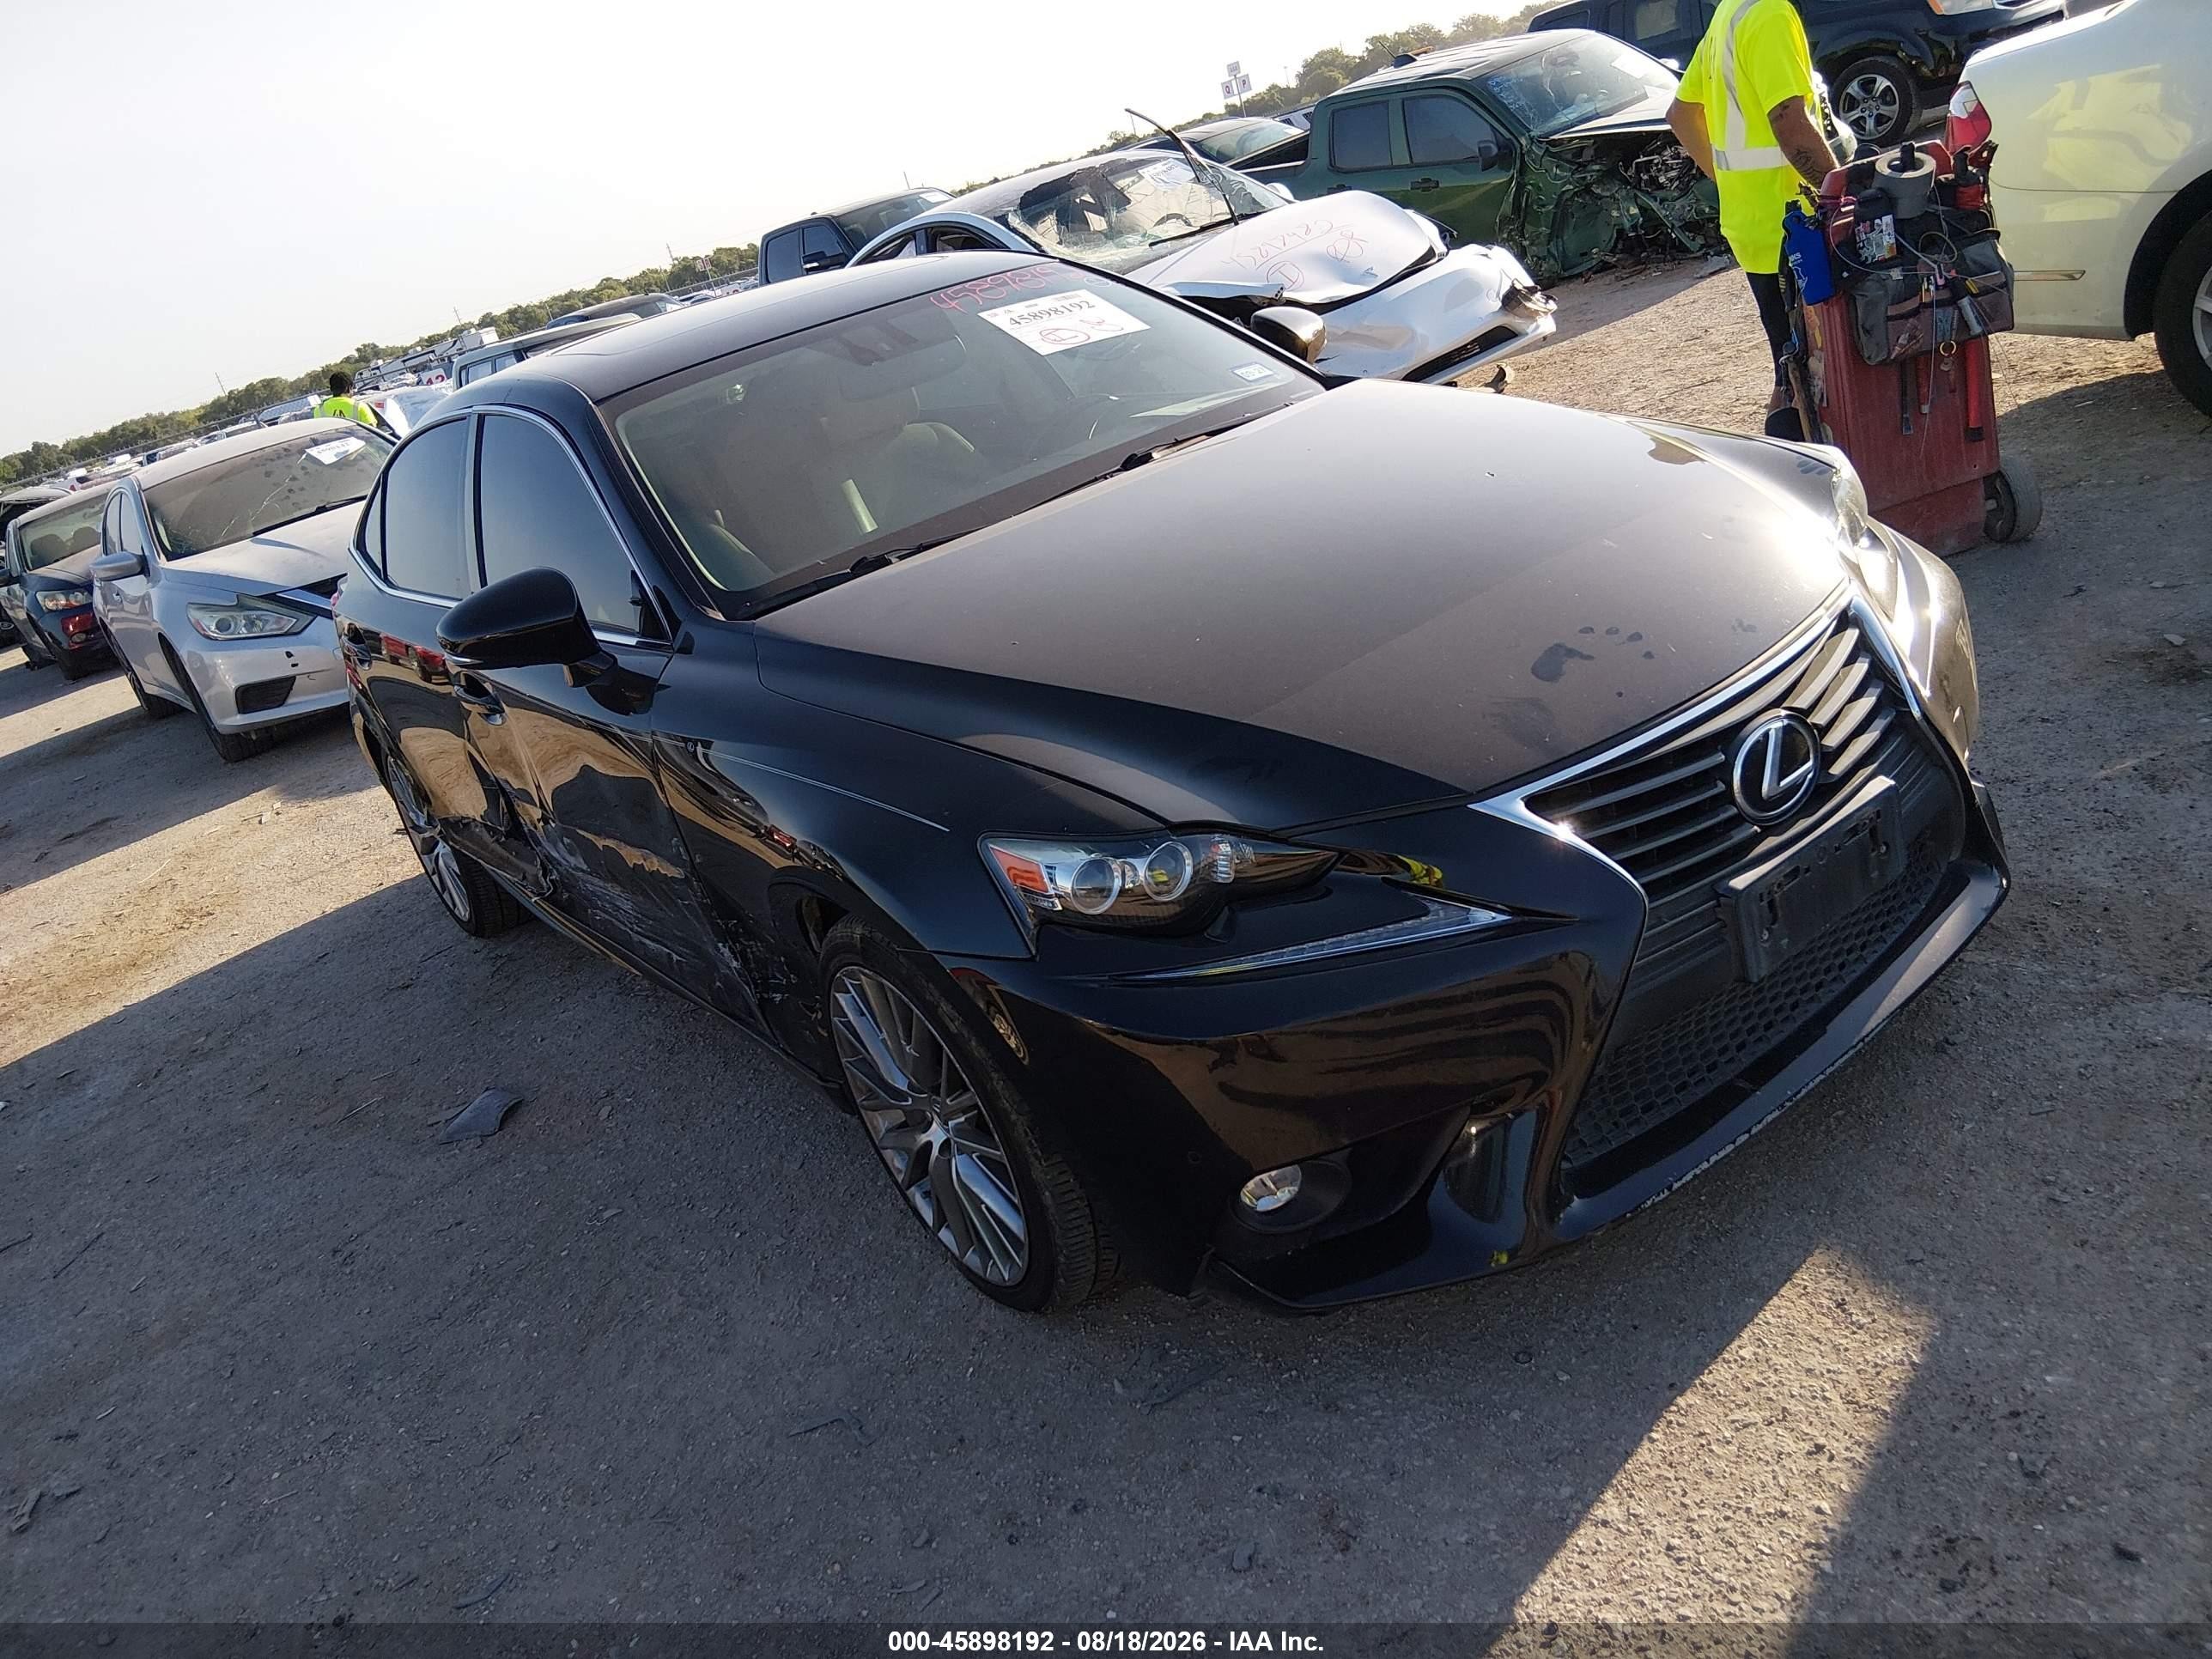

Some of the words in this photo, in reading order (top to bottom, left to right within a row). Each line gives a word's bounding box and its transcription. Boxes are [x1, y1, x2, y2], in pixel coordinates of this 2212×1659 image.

[1242, 79, 1246, 88] P
[1224, 85, 1231, 94] Q
[1009, 301, 1096, 326] 45898192
